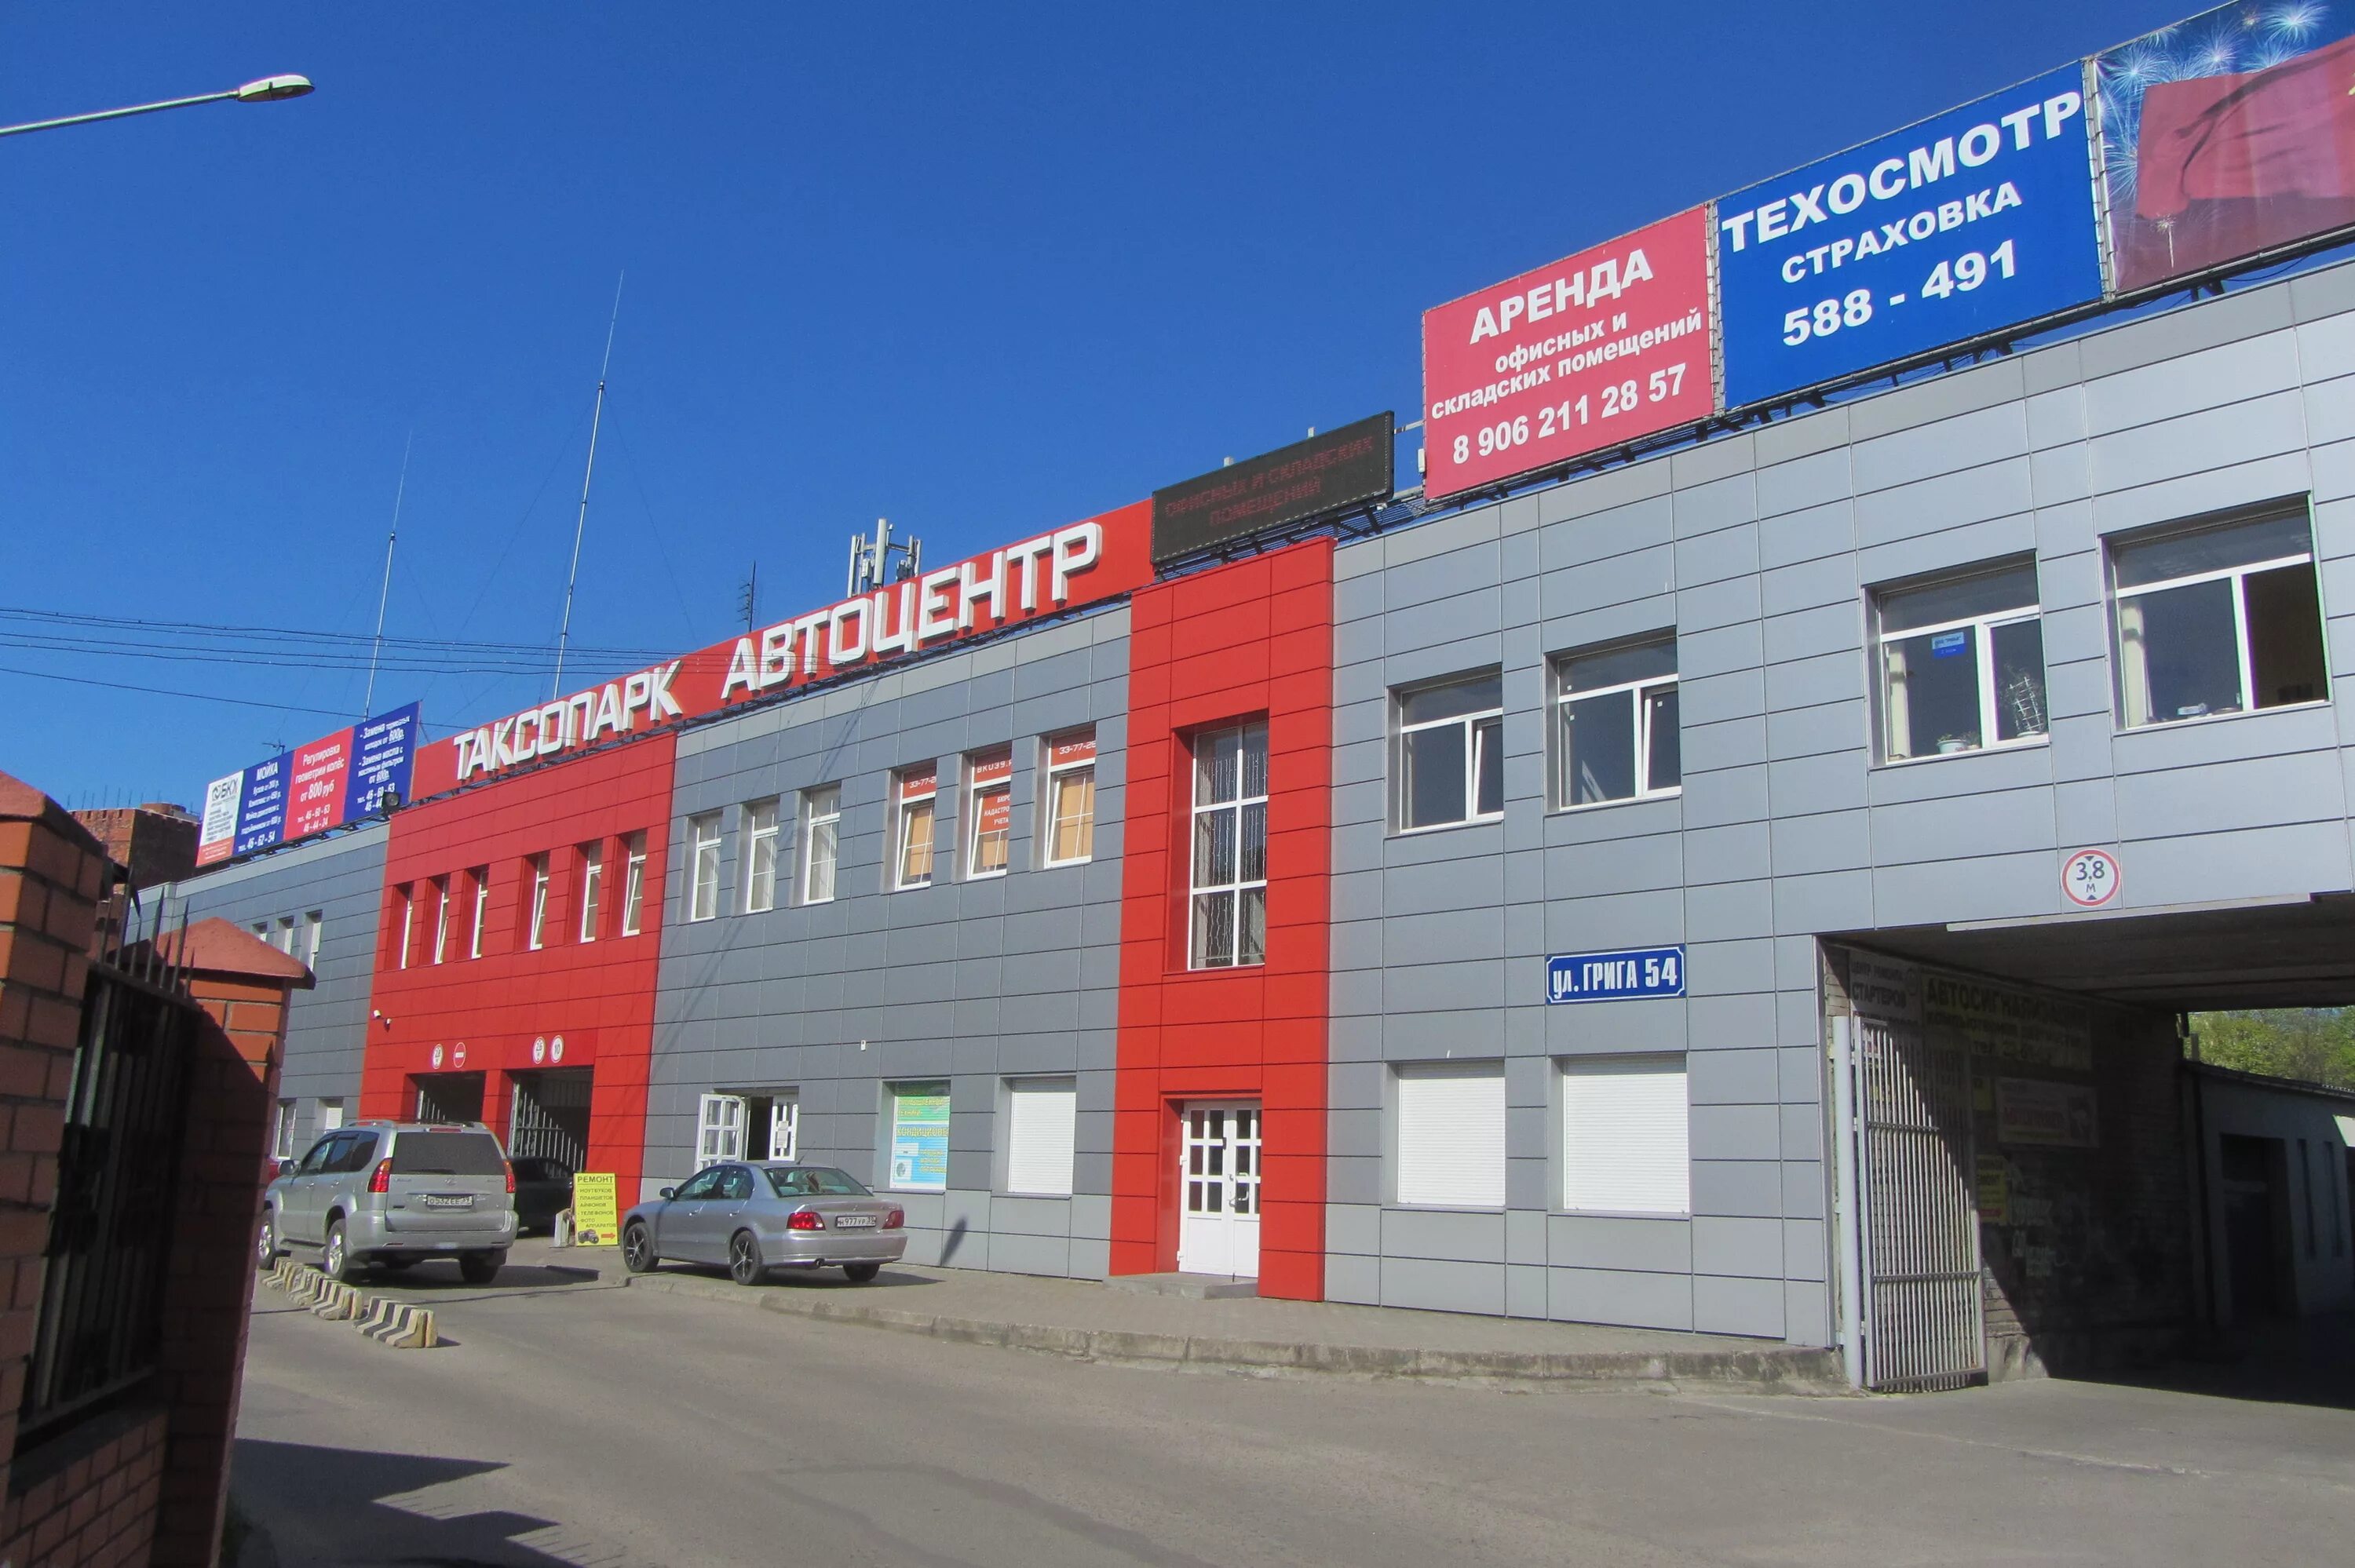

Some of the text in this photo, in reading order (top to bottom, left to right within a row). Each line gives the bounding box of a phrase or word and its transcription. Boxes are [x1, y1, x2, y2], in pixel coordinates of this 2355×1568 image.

[1721, 92, 2082, 252] ТЕХОСМОТР
[1781, 181, 2023, 283] СТРАХОВКА
[1469, 249, 1655, 345] АРЕНДА
[1783, 288, 1873, 346] 588
[1921, 239, 2016, 300] 491
[1430, 307, 1703, 419] складских помещений
[1495, 312, 1627, 378] офисных и
[1452, 363, 1687, 465] 8 906 211 28 57
[721, 521, 1103, 699] АВТОЦЕНТР
[302, 744, 341, 767] Регулировка
[453, 659, 684, 782] ТАКСОПАРК
[256, 761, 279, 782] МОЙКА
[294, 764, 327, 785] геометрии
[309, 780, 323, 800] 800
[323, 779, 334, 798] руб
[1553, 957, 1678, 1000] ул. ГРИГА 54
